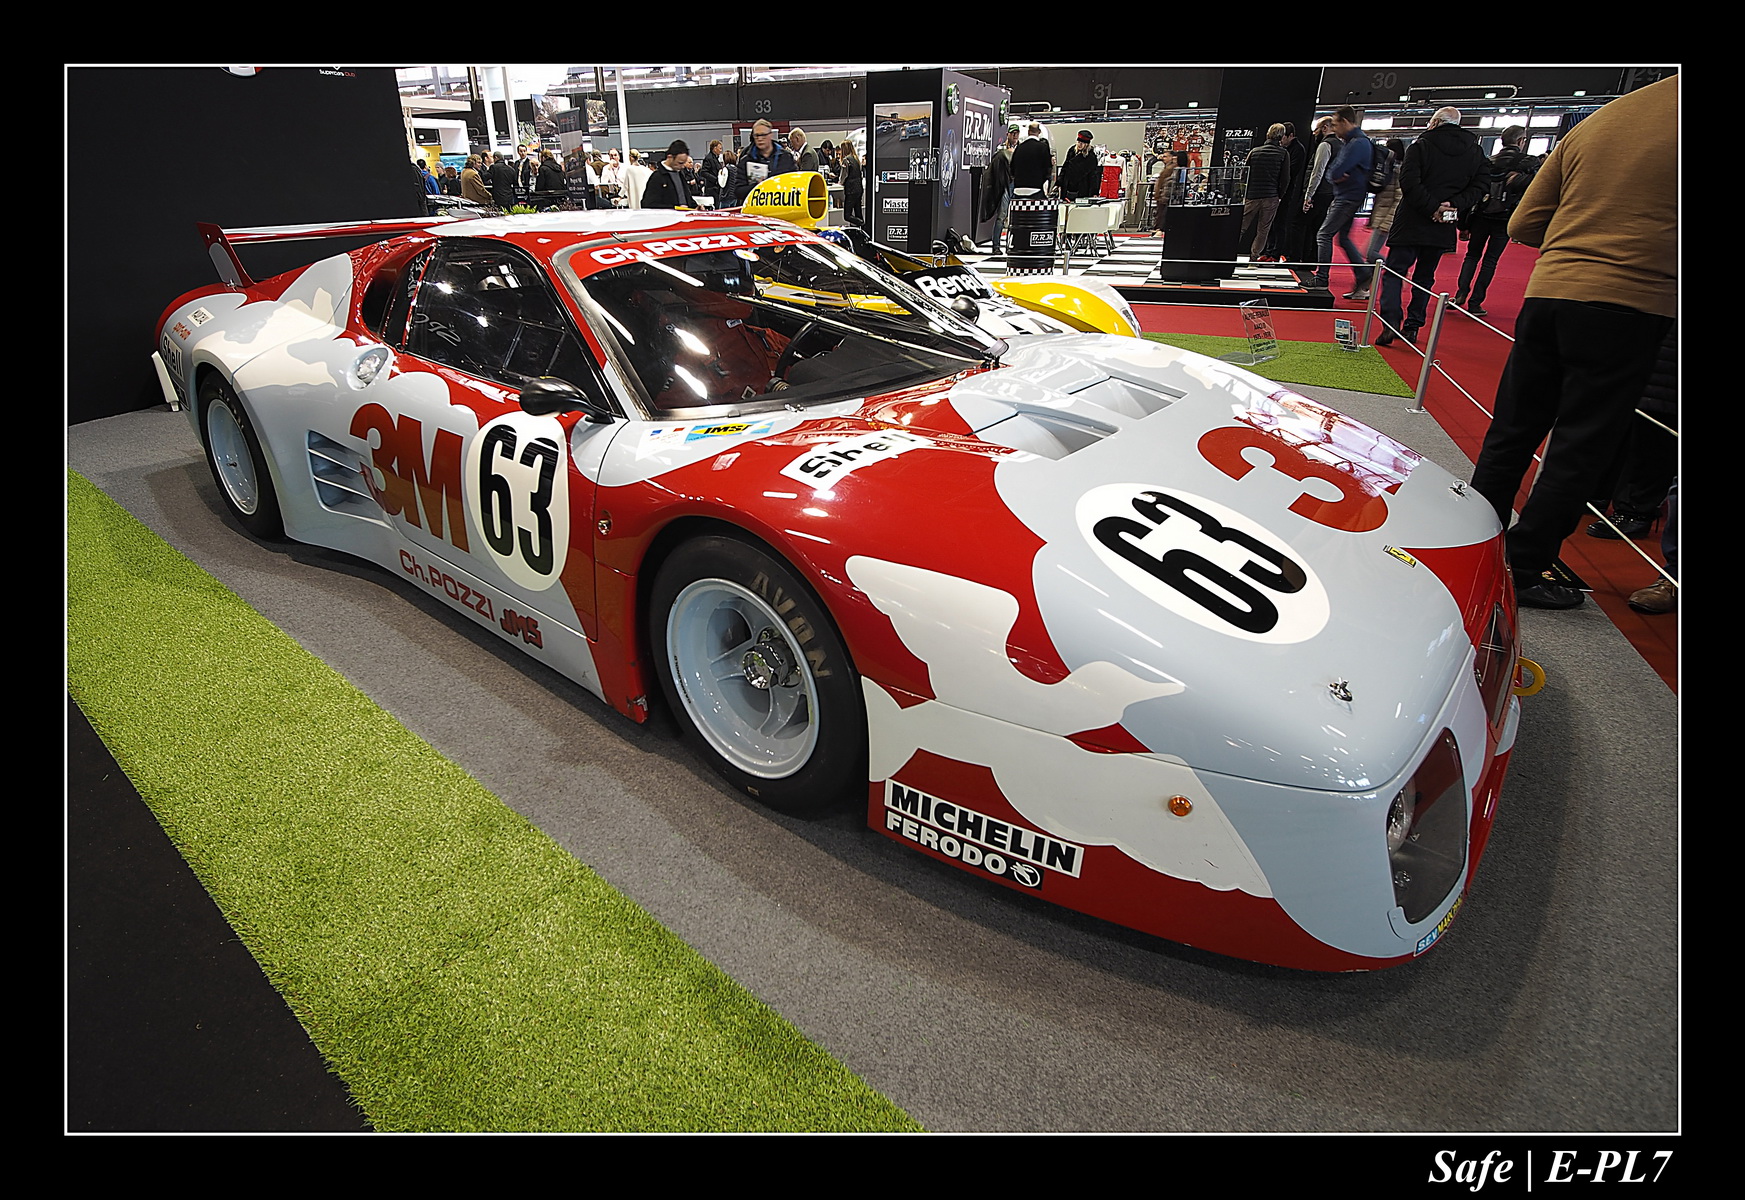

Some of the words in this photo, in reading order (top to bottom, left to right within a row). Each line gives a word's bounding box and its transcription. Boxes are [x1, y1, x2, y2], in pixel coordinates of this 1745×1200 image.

[1094, 83, 1112, 99] 31
[1370, 72, 1397, 89] 30
[755, 100, 772, 113] 33
[1225, 129, 1254, 137] B.R.M
[751, 187, 802, 207] Renault
[748, 230, 796, 245] JMS
[163, 335, 183, 378] Shell
[349, 402, 470, 554] 3M
[479, 424, 560, 576] 63
[1092, 490, 1308, 635] 63
[399, 548, 496, 623] Ch.POZZI
[499, 608, 543, 650] JMS
[750, 570, 833, 679] AVON
[886, 810, 1008, 876] FERODO
[891, 782, 1078, 874] MICHELIN
[1417, 927, 1438, 951] SEV
